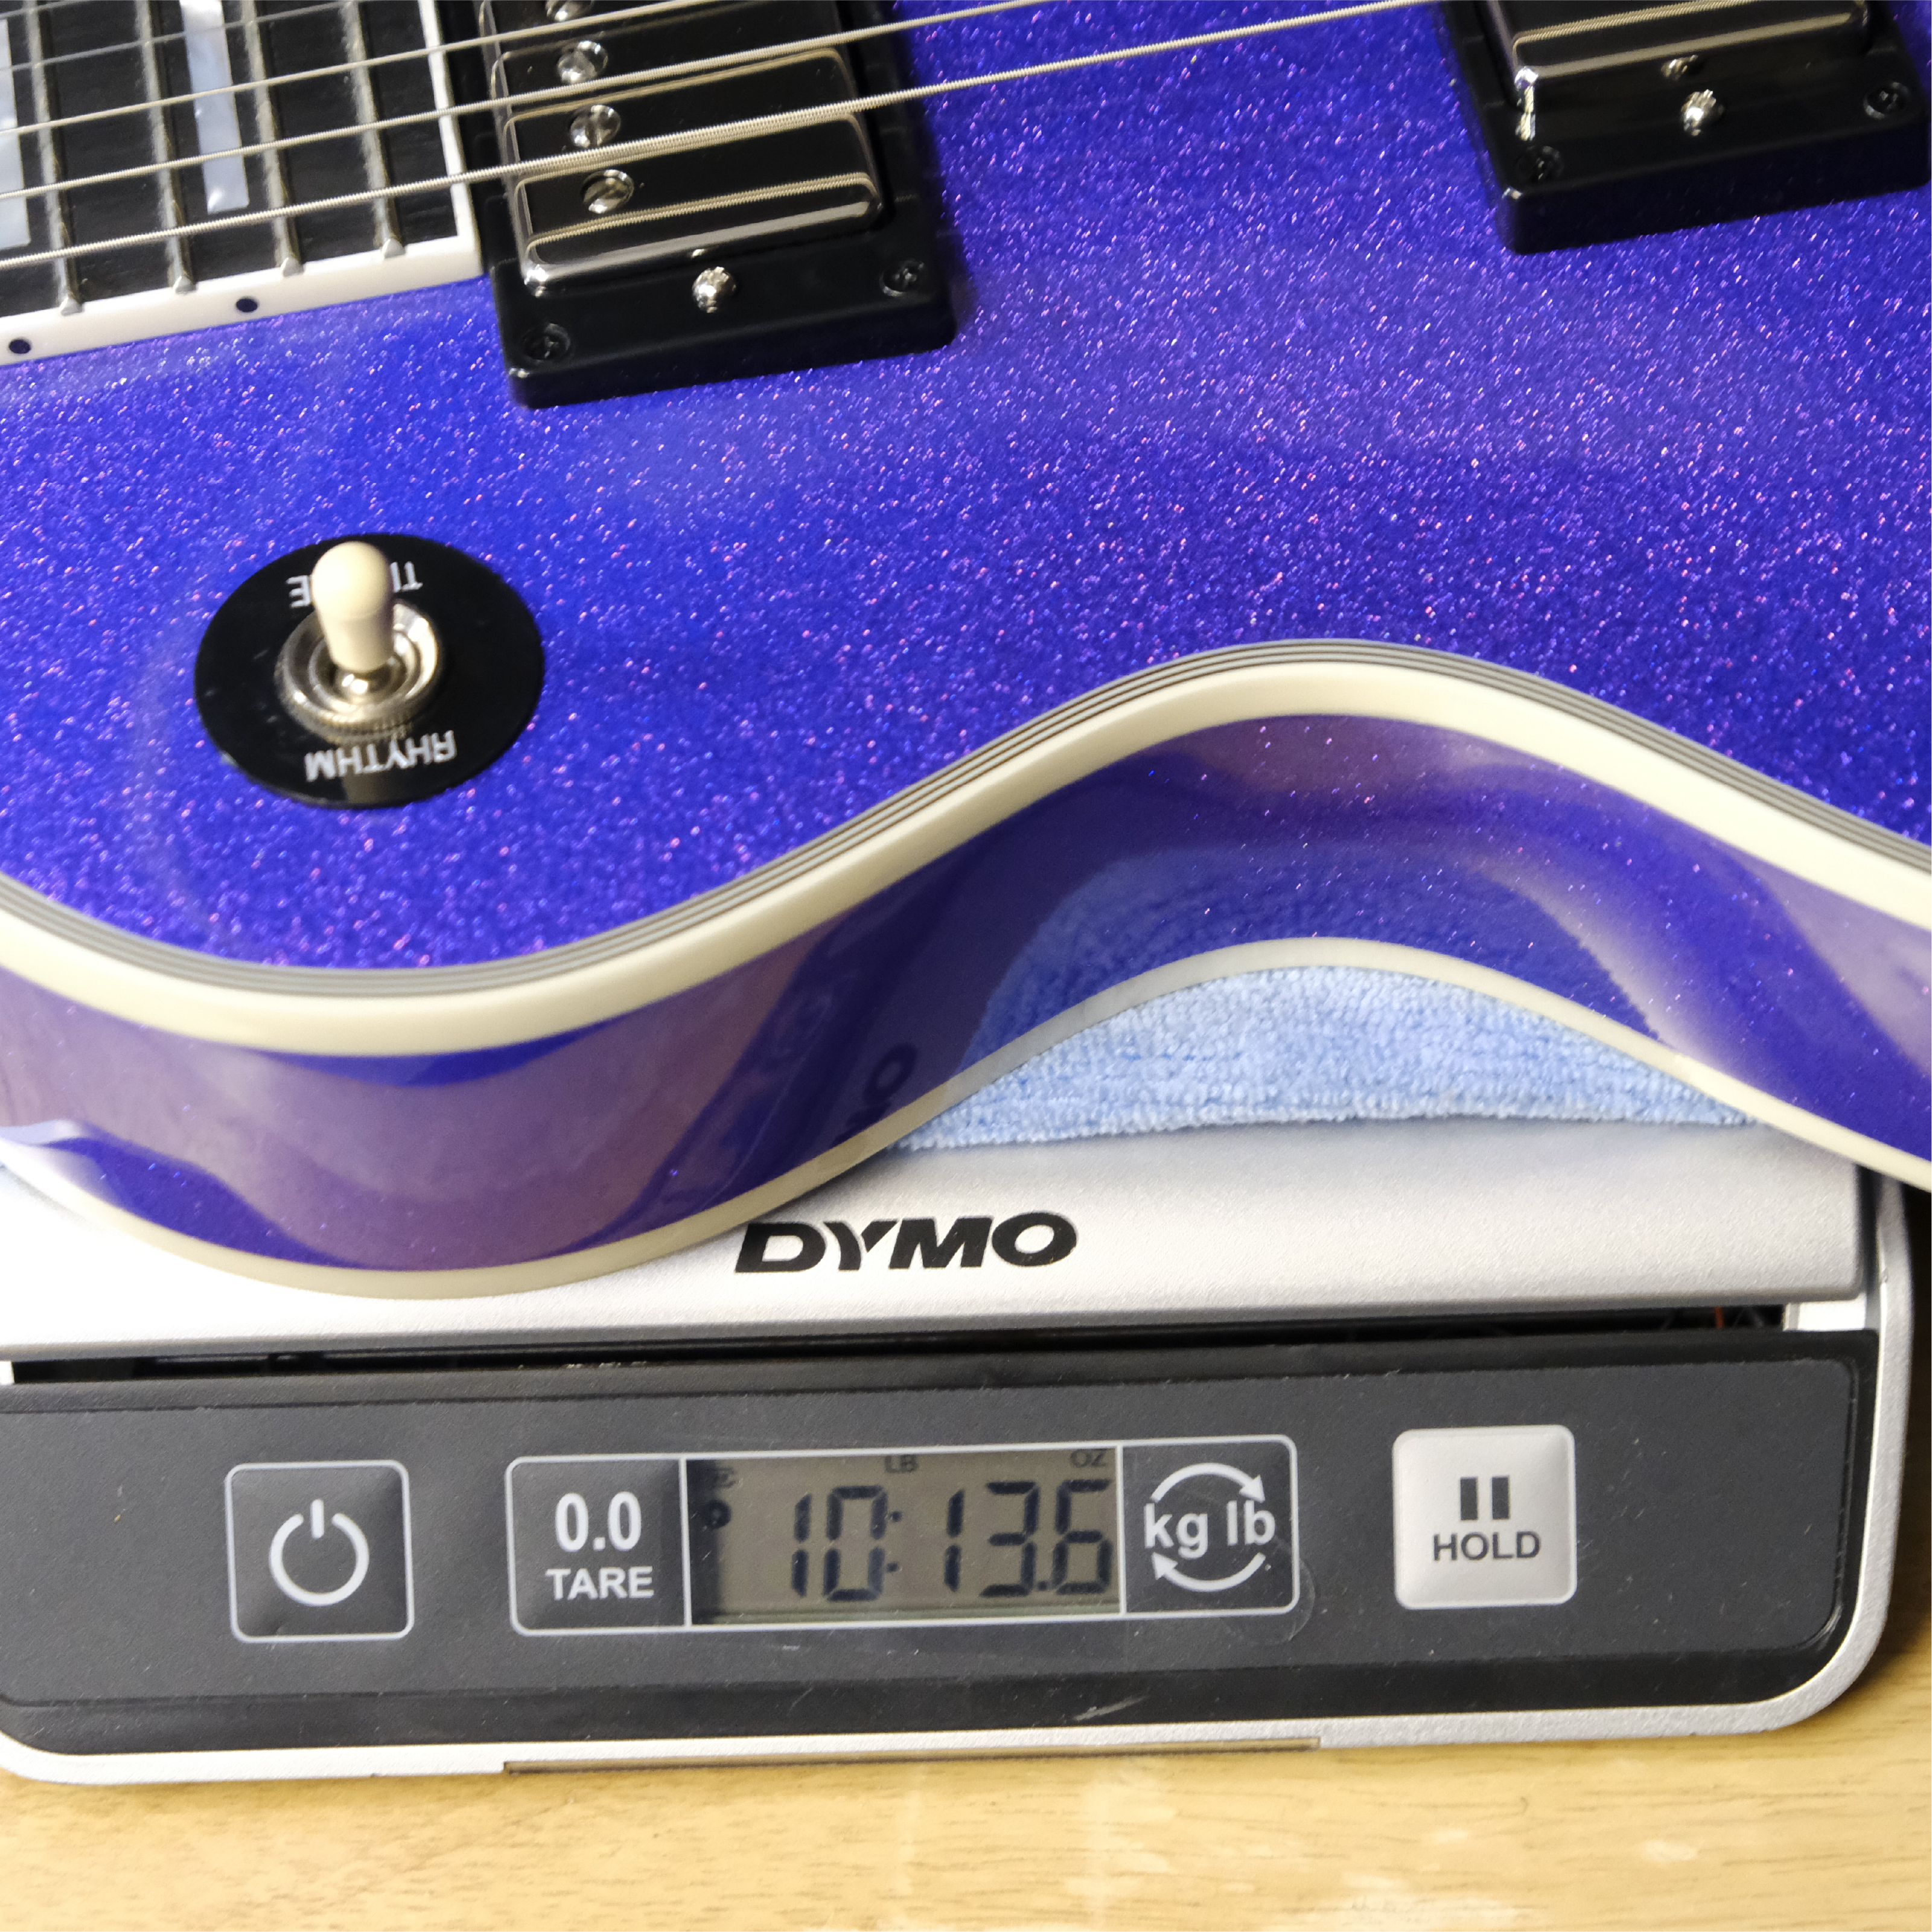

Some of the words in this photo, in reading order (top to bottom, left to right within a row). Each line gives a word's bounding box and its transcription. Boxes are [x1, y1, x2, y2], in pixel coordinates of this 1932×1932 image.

[305, 730, 457, 782] RHYTHM
[735, 1211, 1077, 1273] DYMO
[884, 1454, 919, 1473] LB
[555, 1491, 642, 1552] 0.0
[1144, 1503, 1208, 1560] kg
[1226, 1500, 1275, 1545] lb
[1433, 1531, 1541, 1561] HOLD
[544, 1566, 654, 1600] TARE
